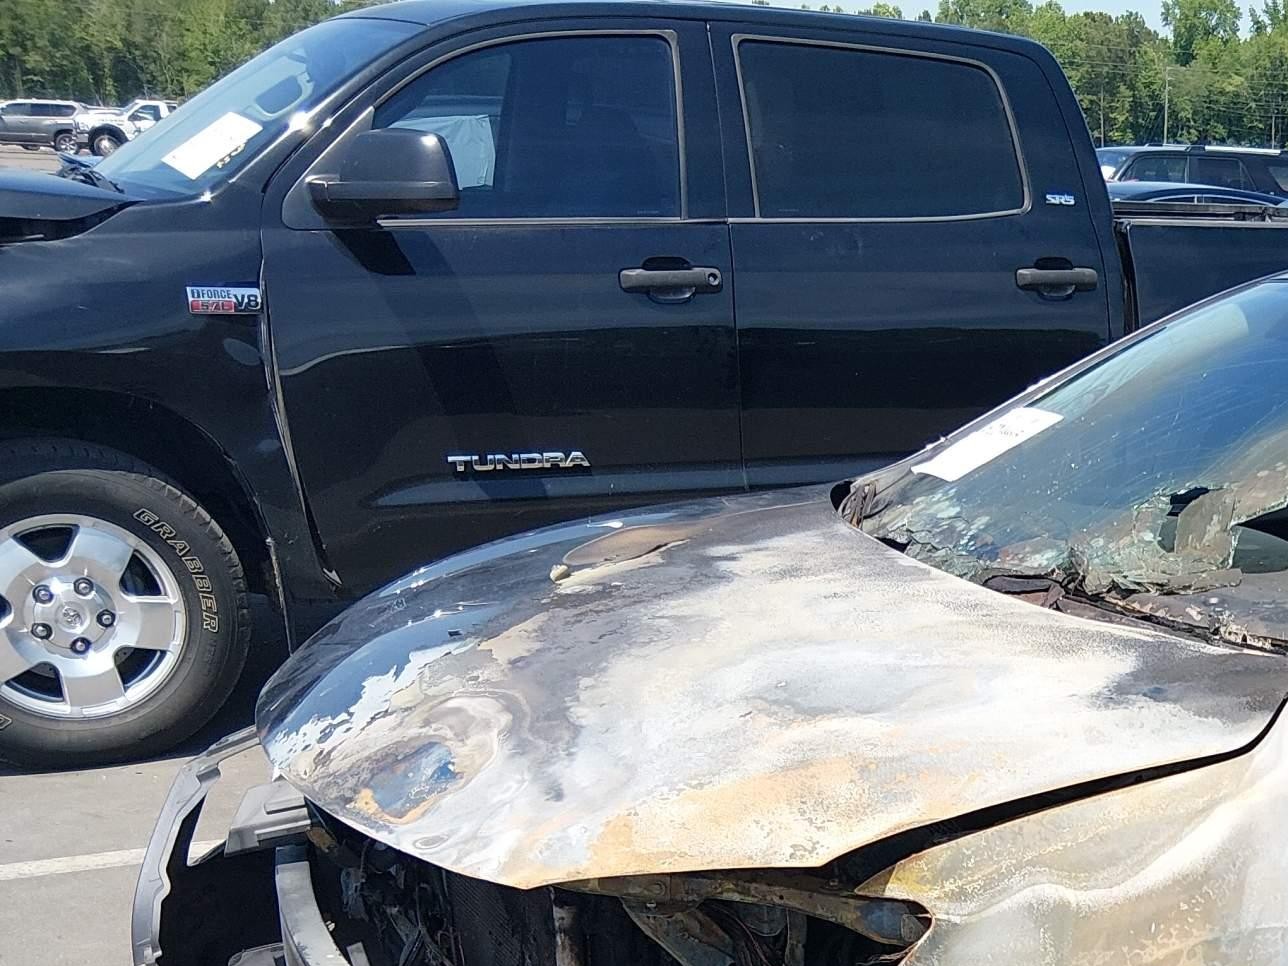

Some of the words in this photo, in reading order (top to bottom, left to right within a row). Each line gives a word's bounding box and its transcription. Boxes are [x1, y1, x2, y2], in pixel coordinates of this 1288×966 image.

[233, 294, 259, 311] V8
[447, 451, 591, 472] TUNDRA
[132, 508, 219, 633] GRABBER
